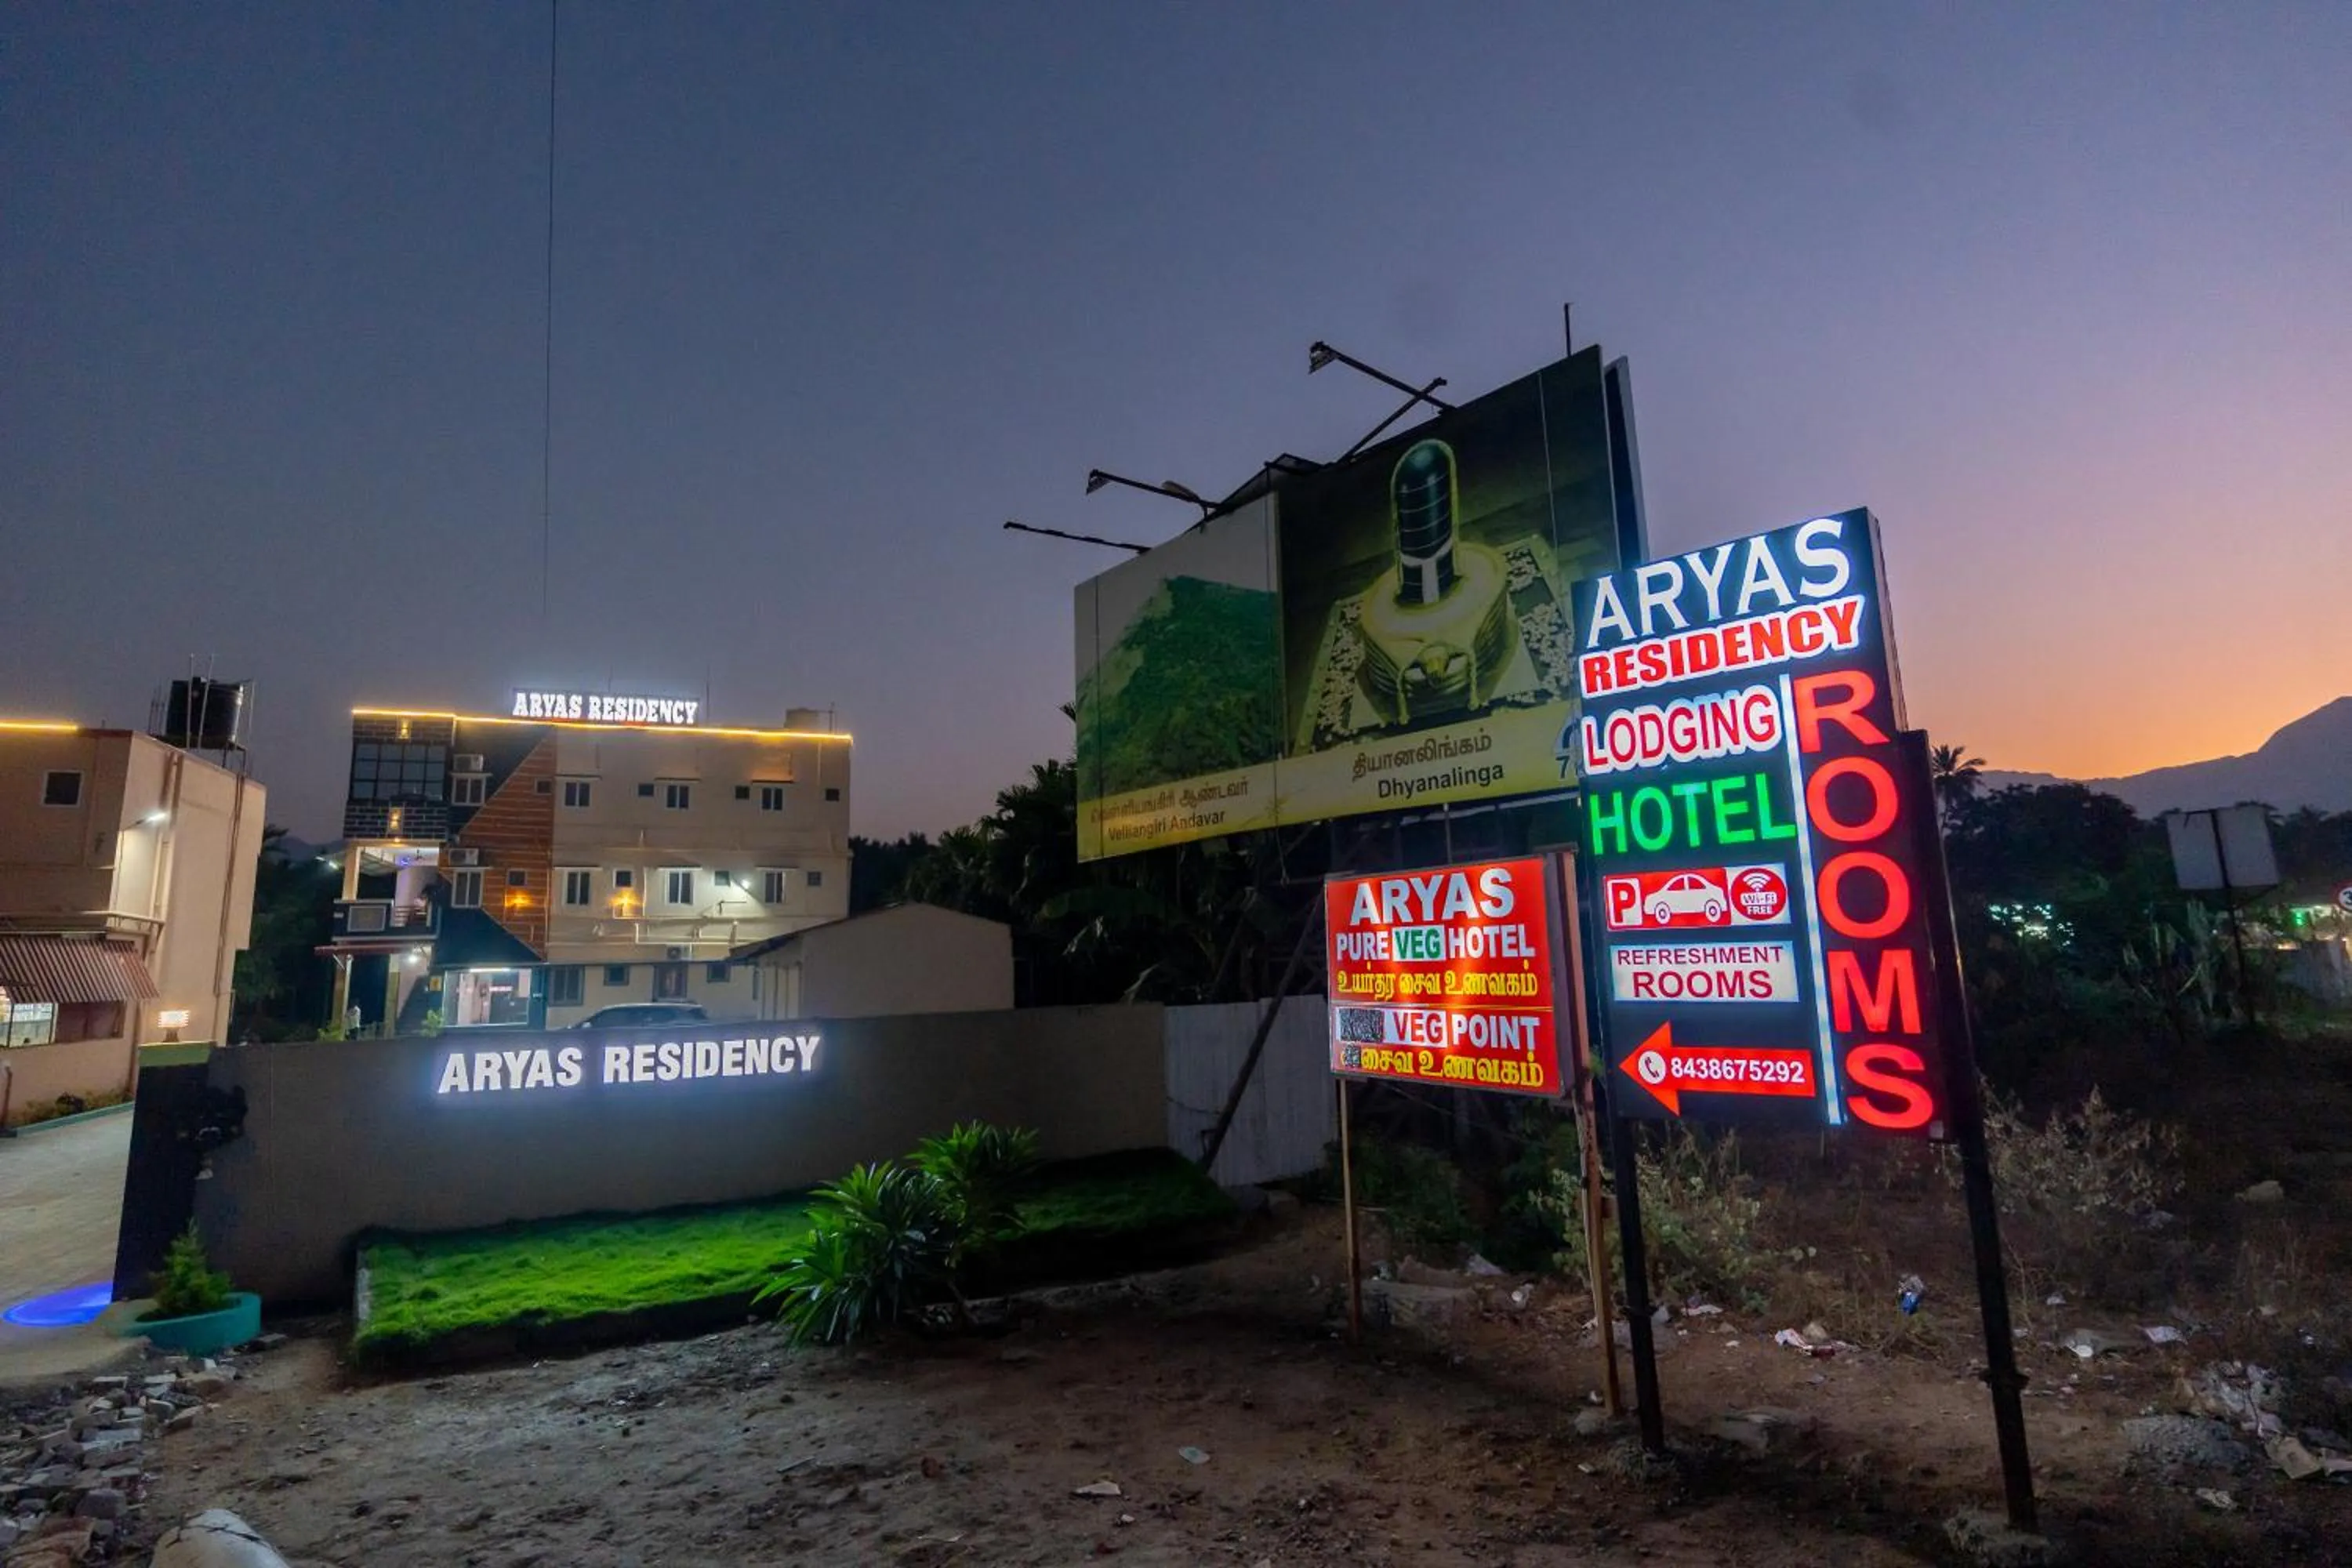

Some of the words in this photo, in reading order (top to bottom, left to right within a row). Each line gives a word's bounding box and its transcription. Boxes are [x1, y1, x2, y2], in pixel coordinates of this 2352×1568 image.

[1587, 518, 1850, 648] ARYAS
[1581, 597, 1861, 696] RESIDENCY
[512, 692, 583, 719] ARYAS
[588, 695, 699, 724] RESIDENCY
[1584, 691, 1777, 770] LODGING
[1378, 764, 1504, 799] Dhyanalinga
[1169, 810, 1225, 830] Andavar
[1590, 773, 1796, 855] HOTEL
[1350, 868, 1515, 926] ARYAS
[1611, 882, 1636, 924] P
[1743, 893, 1775, 904] Wi-Fi
[1747, 906, 1773, 915] FREE
[1794, 670, 1934, 1129] ROOMS
[1336, 931, 1389, 960] PURE
[1395, 928, 1442, 960] VEG
[1450, 924, 1536, 959] HOTEL
[1617, 946, 1784, 965] REFRESHMENT
[1444, 960, 1538, 996] உணவகம்
[1632, 971, 1773, 999] ROOMS
[1392, 1011, 1443, 1044] VEG
[1453, 1014, 1541, 1050] POINT
[438, 1047, 583, 1094] ARYAS
[603, 1036, 821, 1083] RESIDENCY
[1418, 1050, 1544, 1087] உணவகம்
[1671, 1058, 1805, 1083] 8438675292
